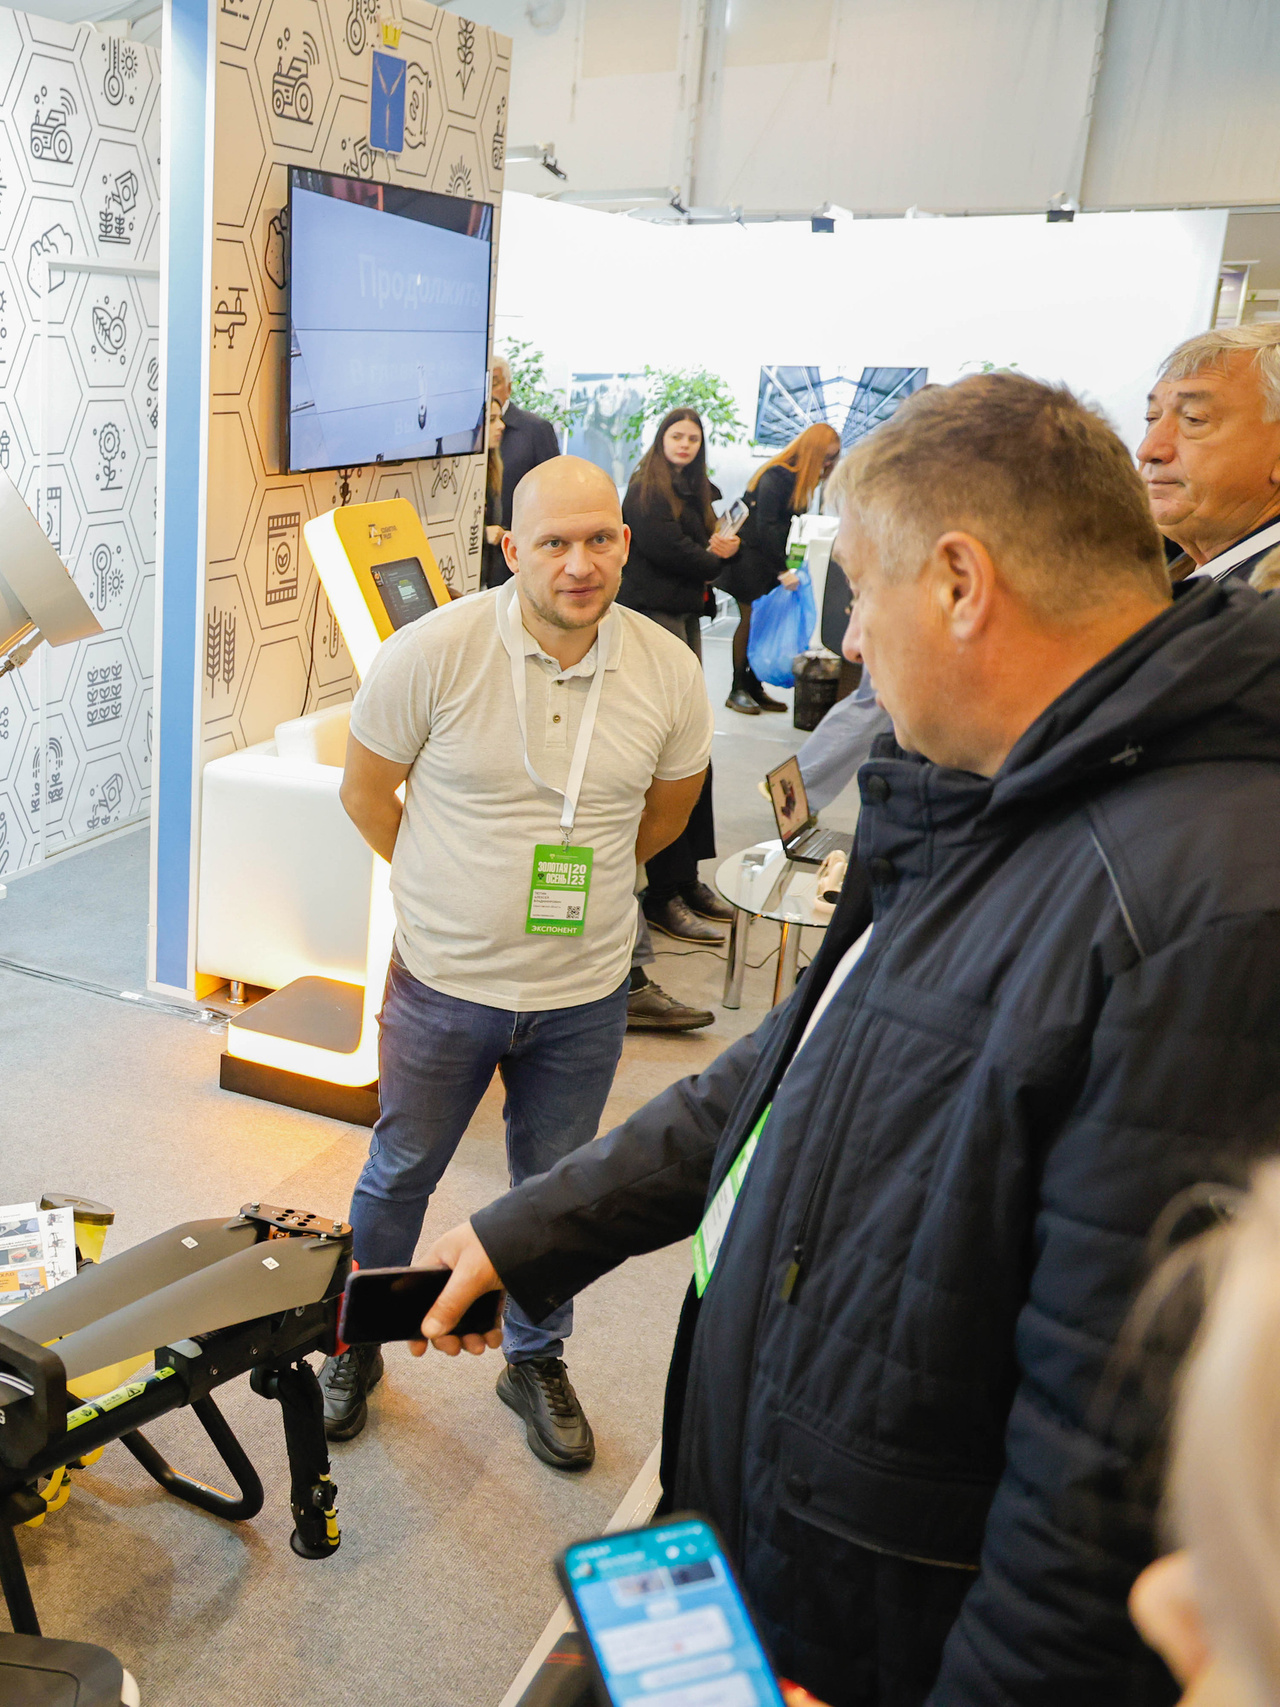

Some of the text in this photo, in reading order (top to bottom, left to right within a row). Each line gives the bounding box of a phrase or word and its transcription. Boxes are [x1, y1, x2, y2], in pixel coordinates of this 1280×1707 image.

[537, 861, 568, 873] ЗОЛОТАЯ
[572, 864, 587, 874] 20
[546, 873, 567, 884] ОСЕНЬ
[571, 875, 585, 885] 23
[531, 925, 577, 934] ЭКСПОНЕНТ
